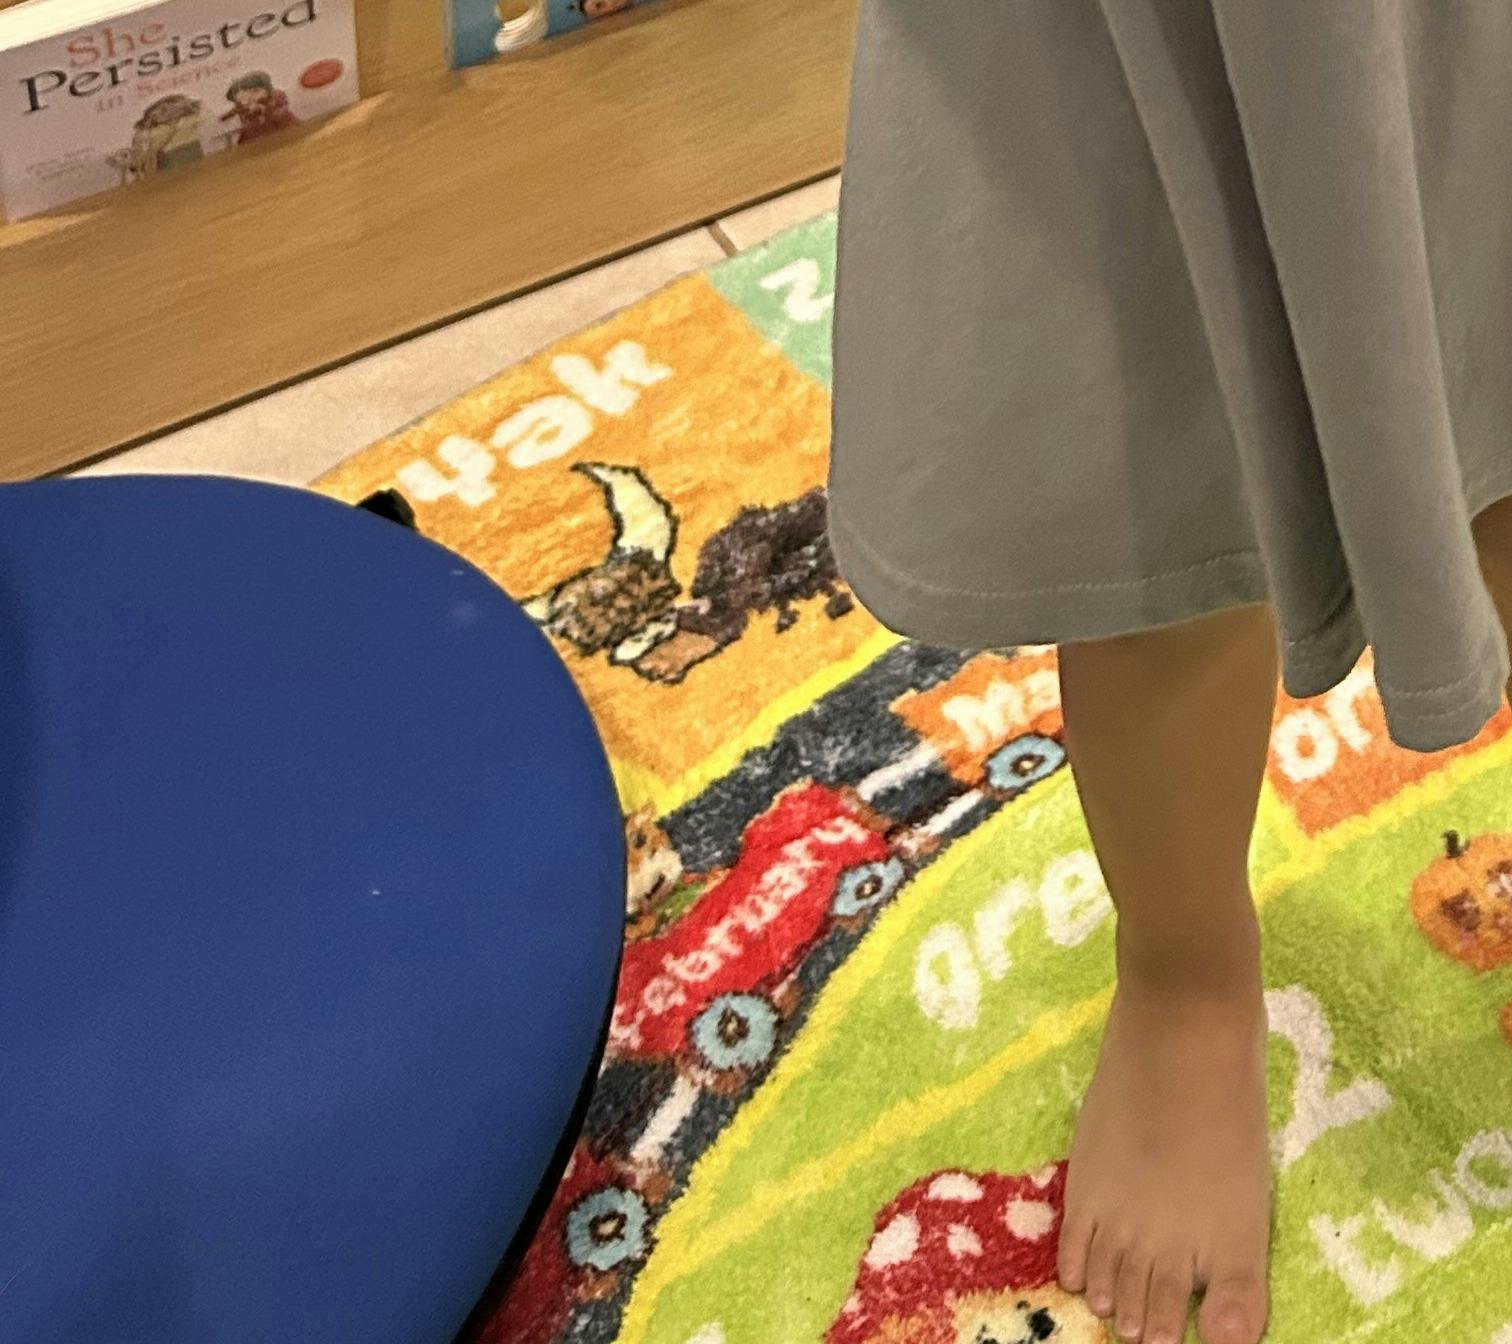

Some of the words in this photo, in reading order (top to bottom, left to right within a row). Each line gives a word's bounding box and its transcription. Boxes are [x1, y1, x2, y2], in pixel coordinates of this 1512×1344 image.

[65, 21, 166, 69] She
[914, 844, 1117, 1032] gre
[1264, 982, 1393, 1174] 2
